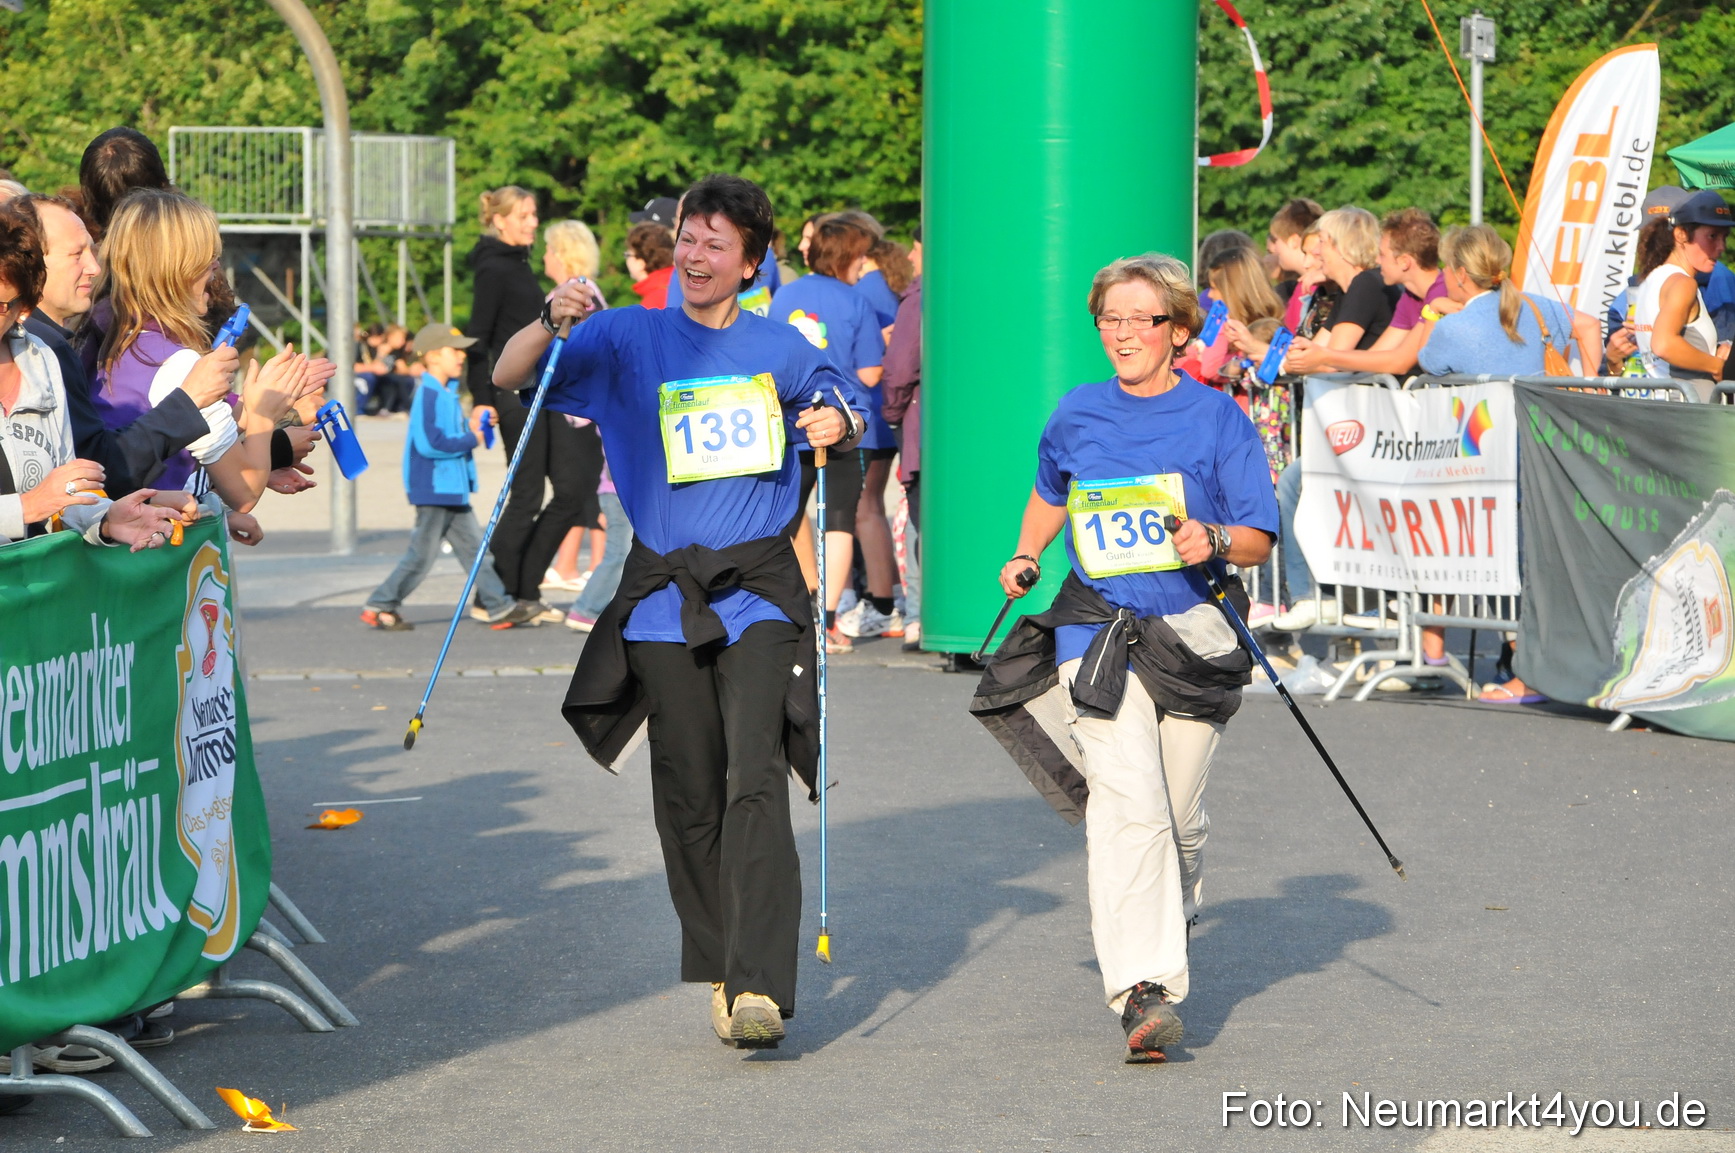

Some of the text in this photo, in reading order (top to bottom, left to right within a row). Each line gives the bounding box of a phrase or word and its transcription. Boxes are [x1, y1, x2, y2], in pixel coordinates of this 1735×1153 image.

[1550, 105, 1620, 310] EBL
[675, 408, 757, 454] 138
[1329, 427, 1360, 447] NEU!
[1371, 430, 1460, 462] Frischmann
[21, 459, 43, 494] 8
[701, 454, 719, 464] Uta
[1611, 466, 1700, 500] Tradition
[1085, 509, 1166, 551] 136
[1574, 491, 1660, 534] Gnuss
[1105, 550, 1135, 562] Gundi
[0, 613, 134, 774] eumarkter
